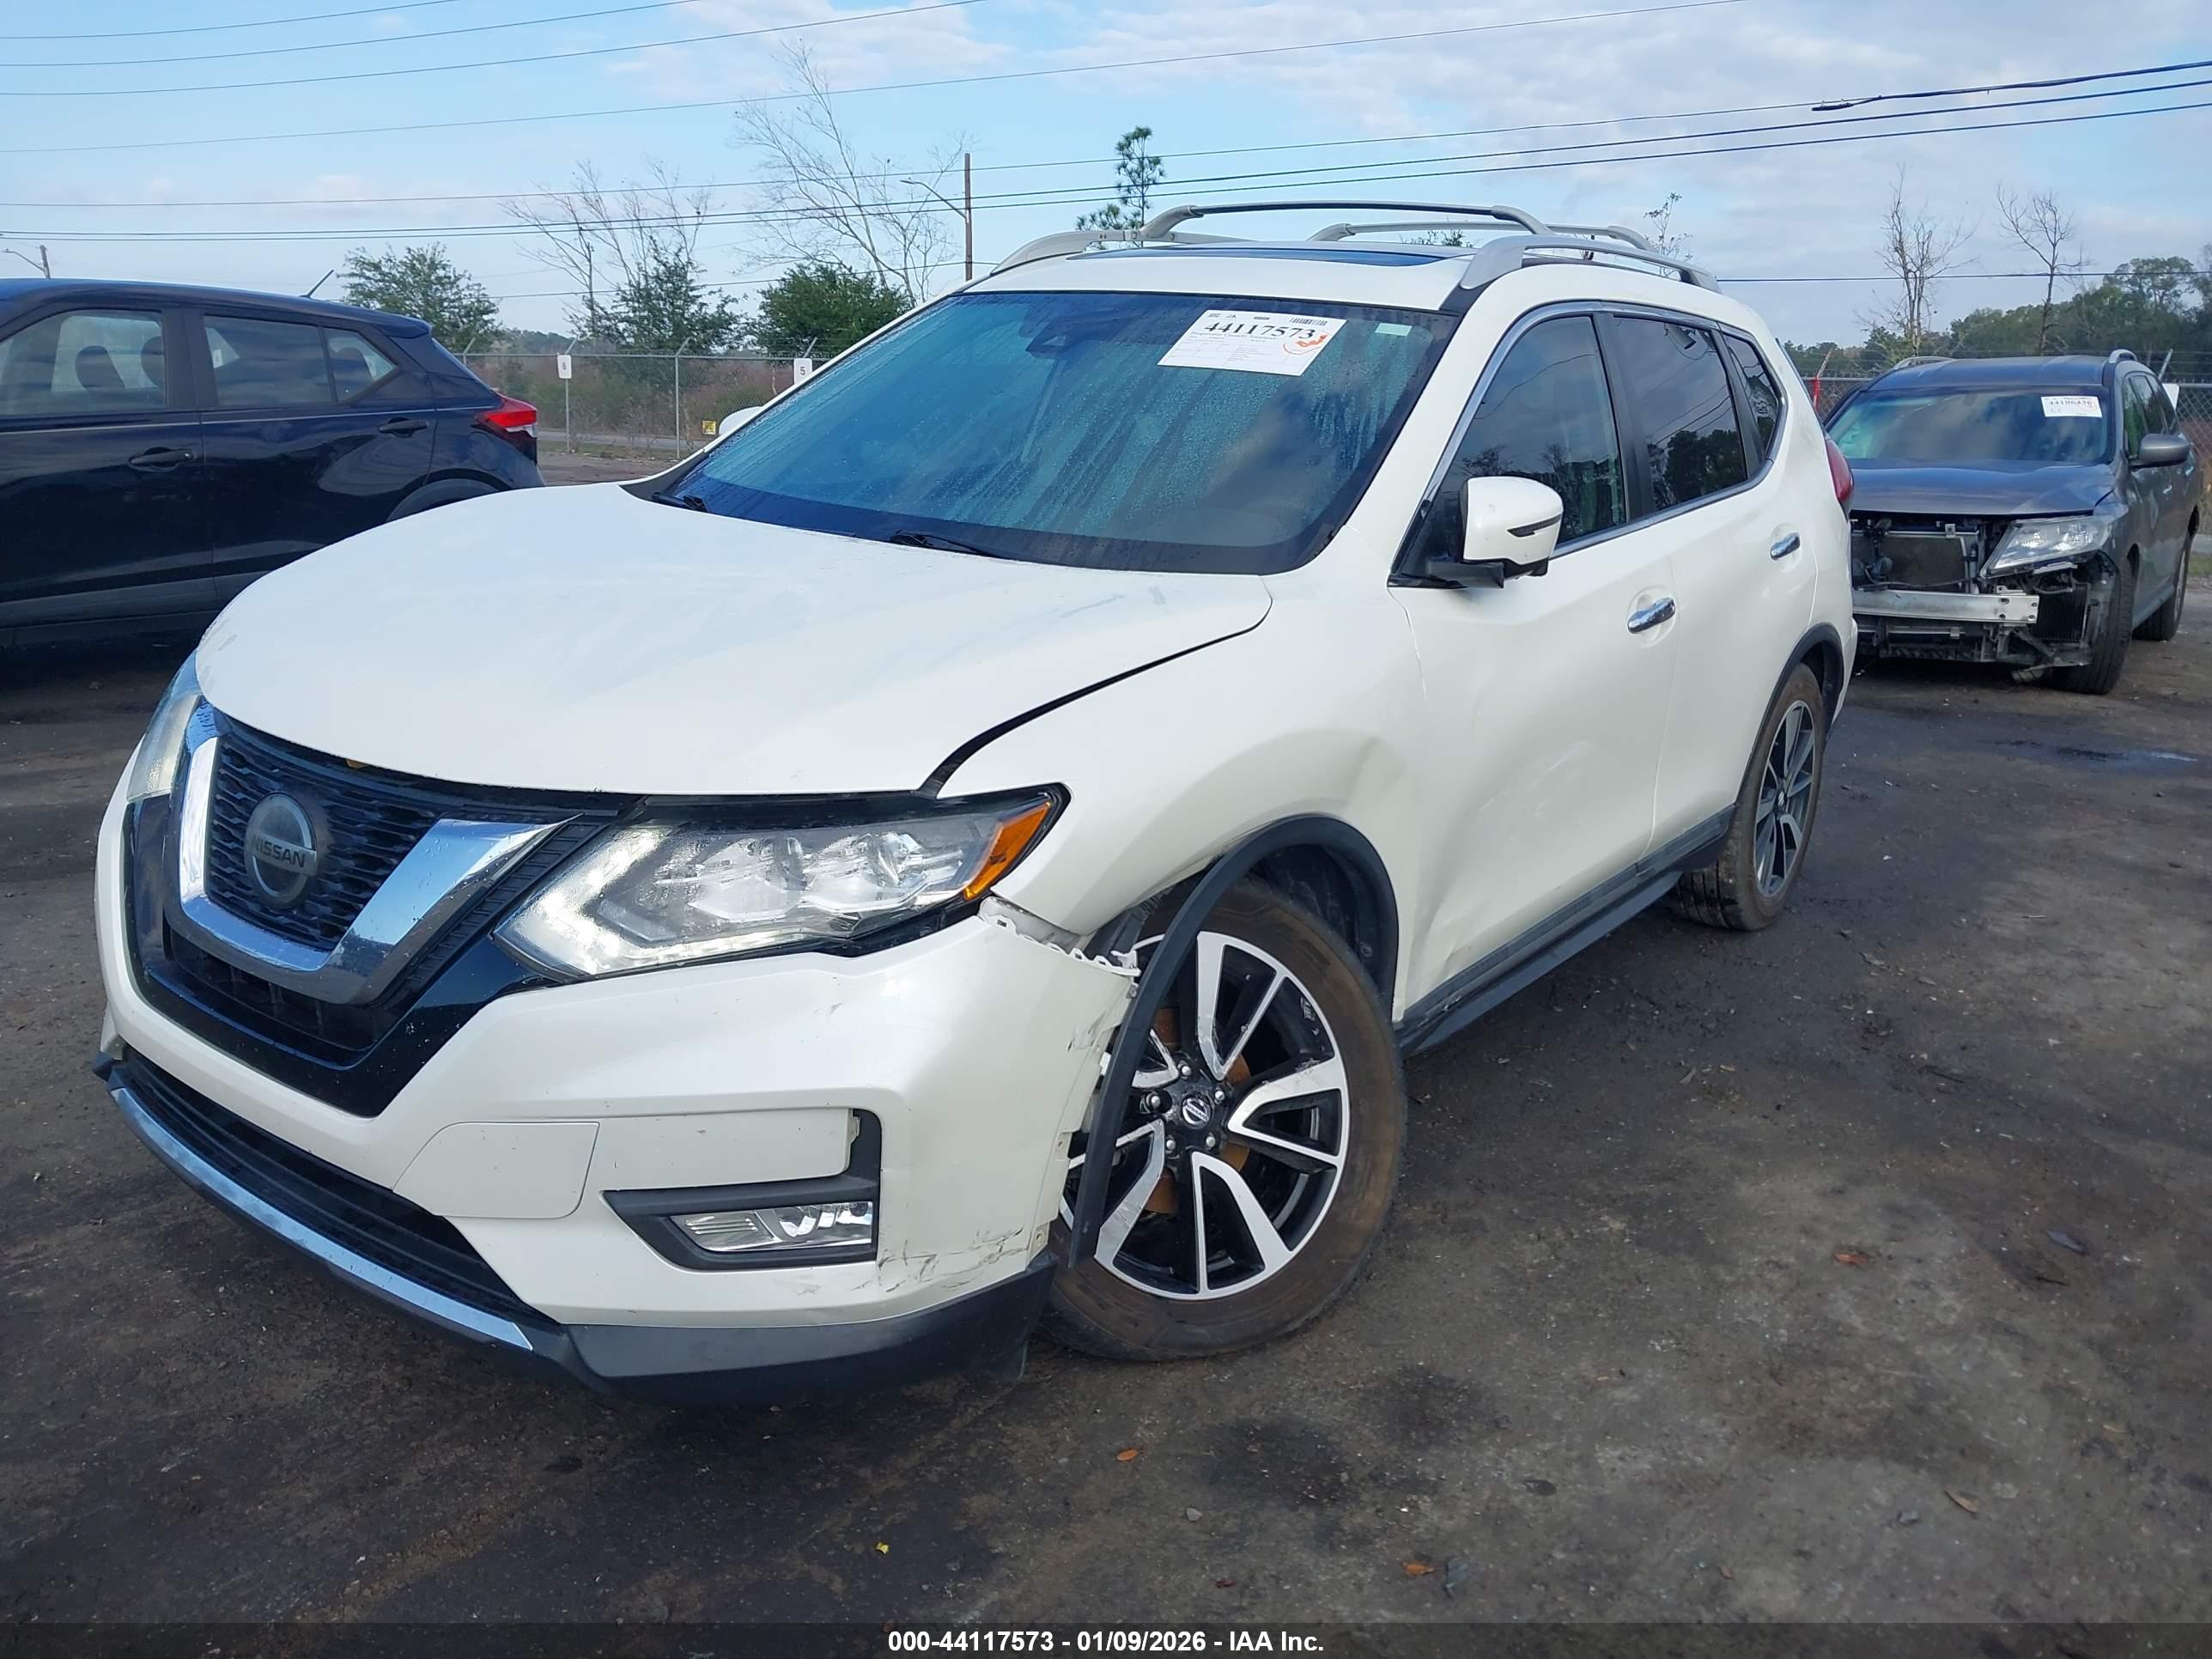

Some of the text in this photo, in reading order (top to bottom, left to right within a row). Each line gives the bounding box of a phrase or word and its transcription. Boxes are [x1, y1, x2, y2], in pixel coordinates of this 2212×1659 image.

[1204, 322, 1316, 339] 44117573
[799, 366, 805, 376] 5
[253, 835, 306, 868] NISSAN
